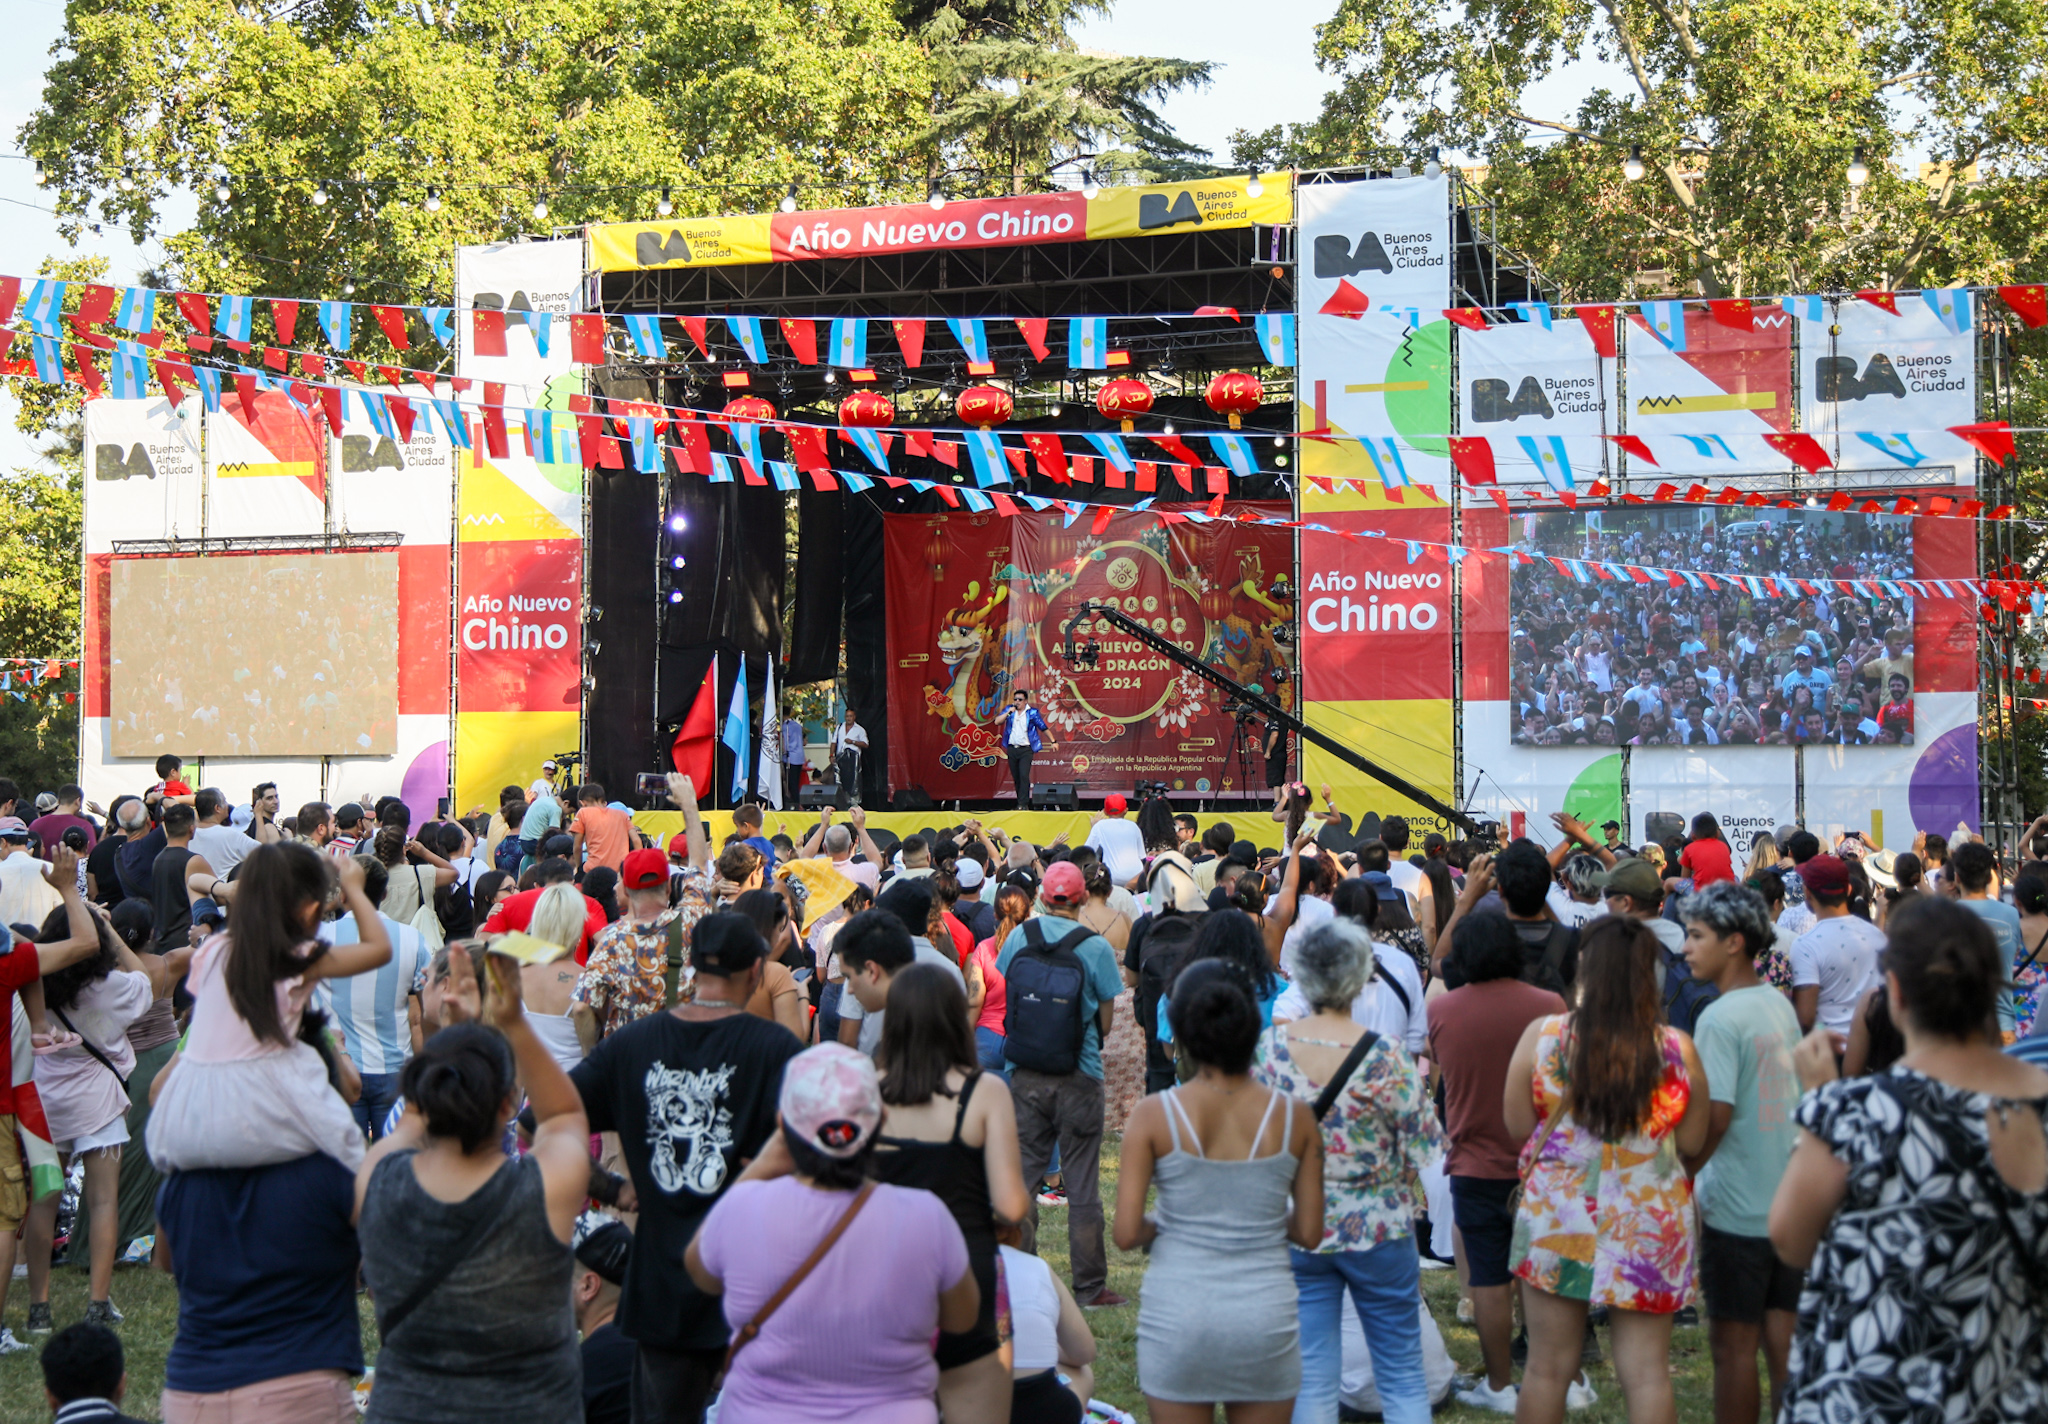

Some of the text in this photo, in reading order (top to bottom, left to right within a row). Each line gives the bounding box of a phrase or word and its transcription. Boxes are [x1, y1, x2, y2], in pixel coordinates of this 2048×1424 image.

[1197, 191, 1237, 201] Buenos
[1203, 201, 1234, 211] Aires
[1207, 209, 1247, 222] Ciudad
[686, 229, 722, 240] Buenos
[788, 209, 1075, 252] Año Nuevo Chino
[693, 239, 719, 250] Aires
[1384, 233, 1432, 245] Buenos
[696, 247, 732, 259] Ciudad
[1392, 245, 1428, 257] Aires
[1396, 254, 1444, 268] Ciudad
[531, 292, 570, 303] Buenos
[538, 303, 567, 313] Aires
[1896, 355, 1952, 367] Buenos
[1906, 367, 1948, 380] Aires
[1545, 378, 1595, 390] Buenos
[1911, 378, 1965, 393] Ciudad
[1554, 390, 1591, 402] Aires
[1557, 399, 1607, 414] Ciudad
[398, 435, 437, 446] Benos
[149, 444, 186, 455] Buenos
[405, 446, 433, 456] Aires
[155, 455, 182, 465] Aires
[408, 455, 446, 466] Ciudad
[159, 464, 193, 475] Ciudad
[1308, 570, 1442, 592] Año Nuevo
[463, 594, 572, 613] Año Nuevo
[1307, 595, 1438, 634] Chino
[463, 616, 569, 651] Chino
[1051, 641, 1085, 655] AO
[1106, 655, 1171, 672] DRAGÓN
[1103, 677, 1142, 690] 2024
[1091, 755, 1227, 765] Embajada de la República Popular China
[1133, 764, 1167, 773] República
[1168, 764, 1203, 773] Argentina
[1403, 816, 1434, 826] enos
[1722, 815, 1775, 827] Buenos
[1408, 829, 1430, 838] res
[1731, 828, 1754, 840] Air
